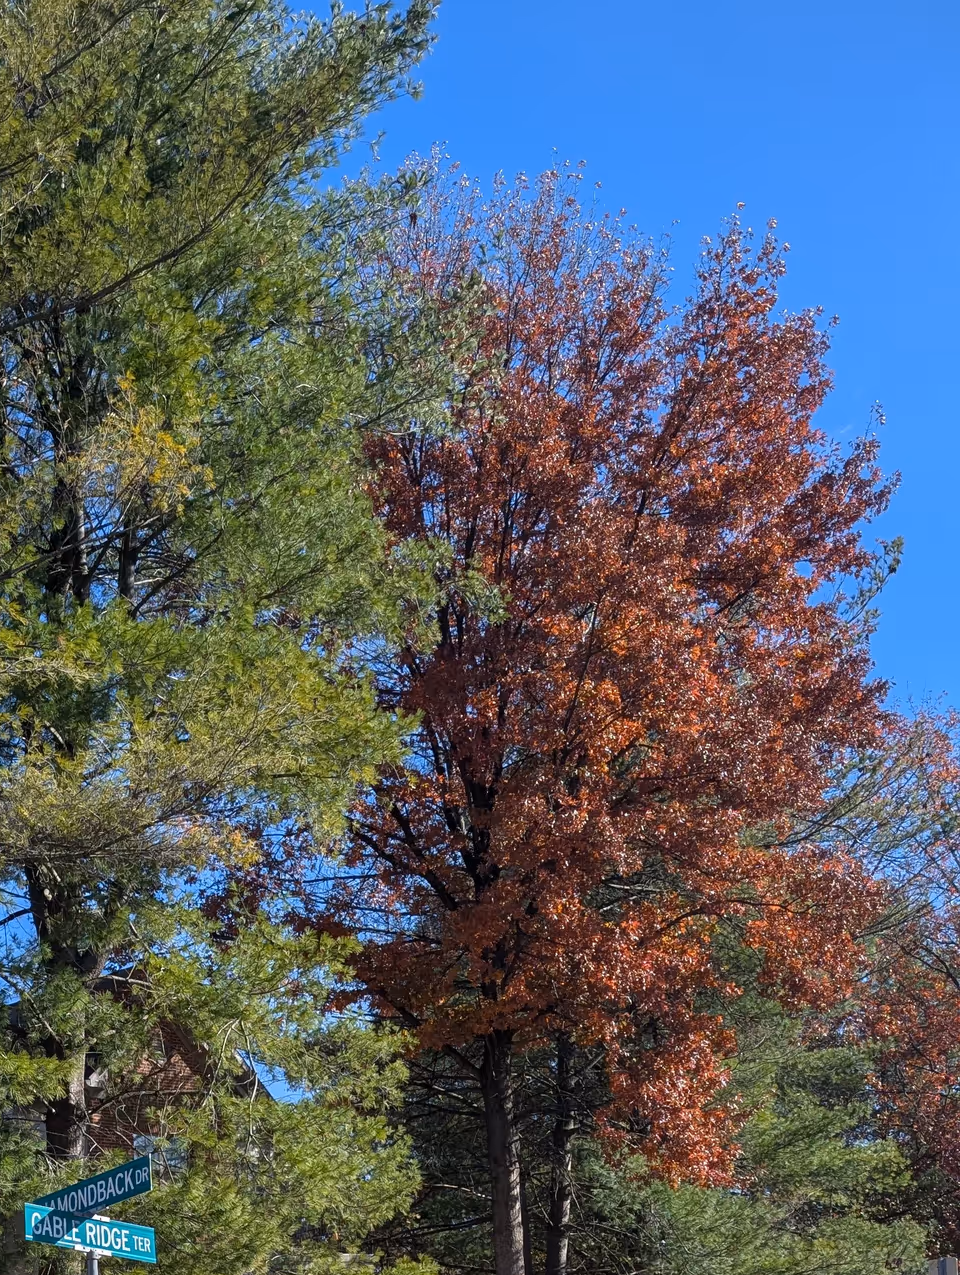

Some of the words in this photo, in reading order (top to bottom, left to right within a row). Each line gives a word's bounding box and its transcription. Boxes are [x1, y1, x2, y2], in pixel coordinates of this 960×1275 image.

[44, 1168, 135, 1212] AMONDBACK
[135, 1166, 149, 1185] DR
[31, 1211, 82, 1243] GABLE
[85, 1222, 131, 1252] RIDGE
[132, 1235, 151, 1253] TER
